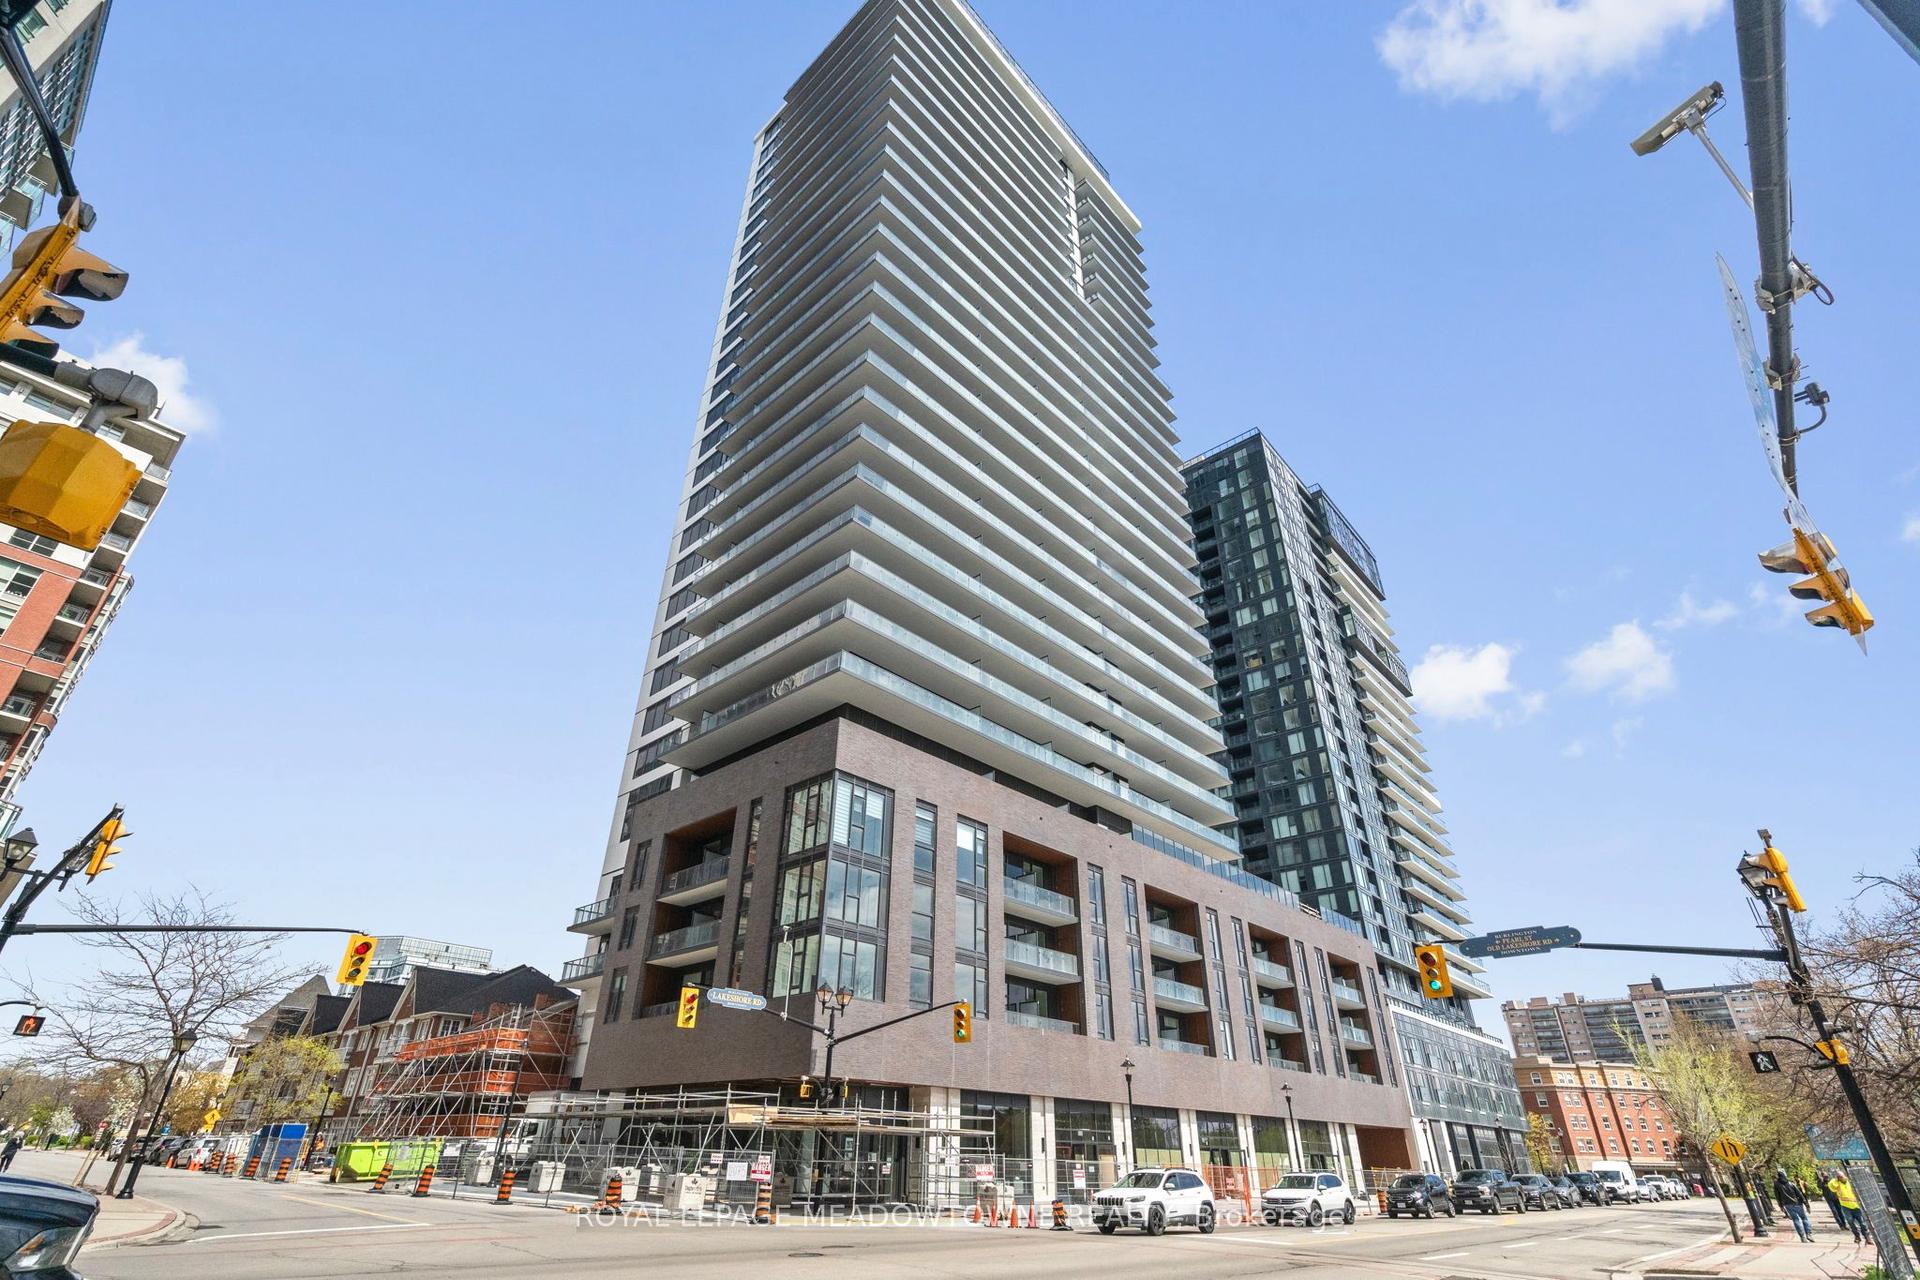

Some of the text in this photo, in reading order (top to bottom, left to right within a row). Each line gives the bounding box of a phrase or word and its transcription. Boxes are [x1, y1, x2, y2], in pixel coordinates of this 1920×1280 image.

[1494, 930, 1537, 939] BURLINGTON
[1502, 936, 1525, 944] PEARL
[1501, 940, 1542, 950] LAKESHORE
[1501, 946, 1541, 955] DOWNTOWN
[712, 991, 752, 1004] LAKESHORE
